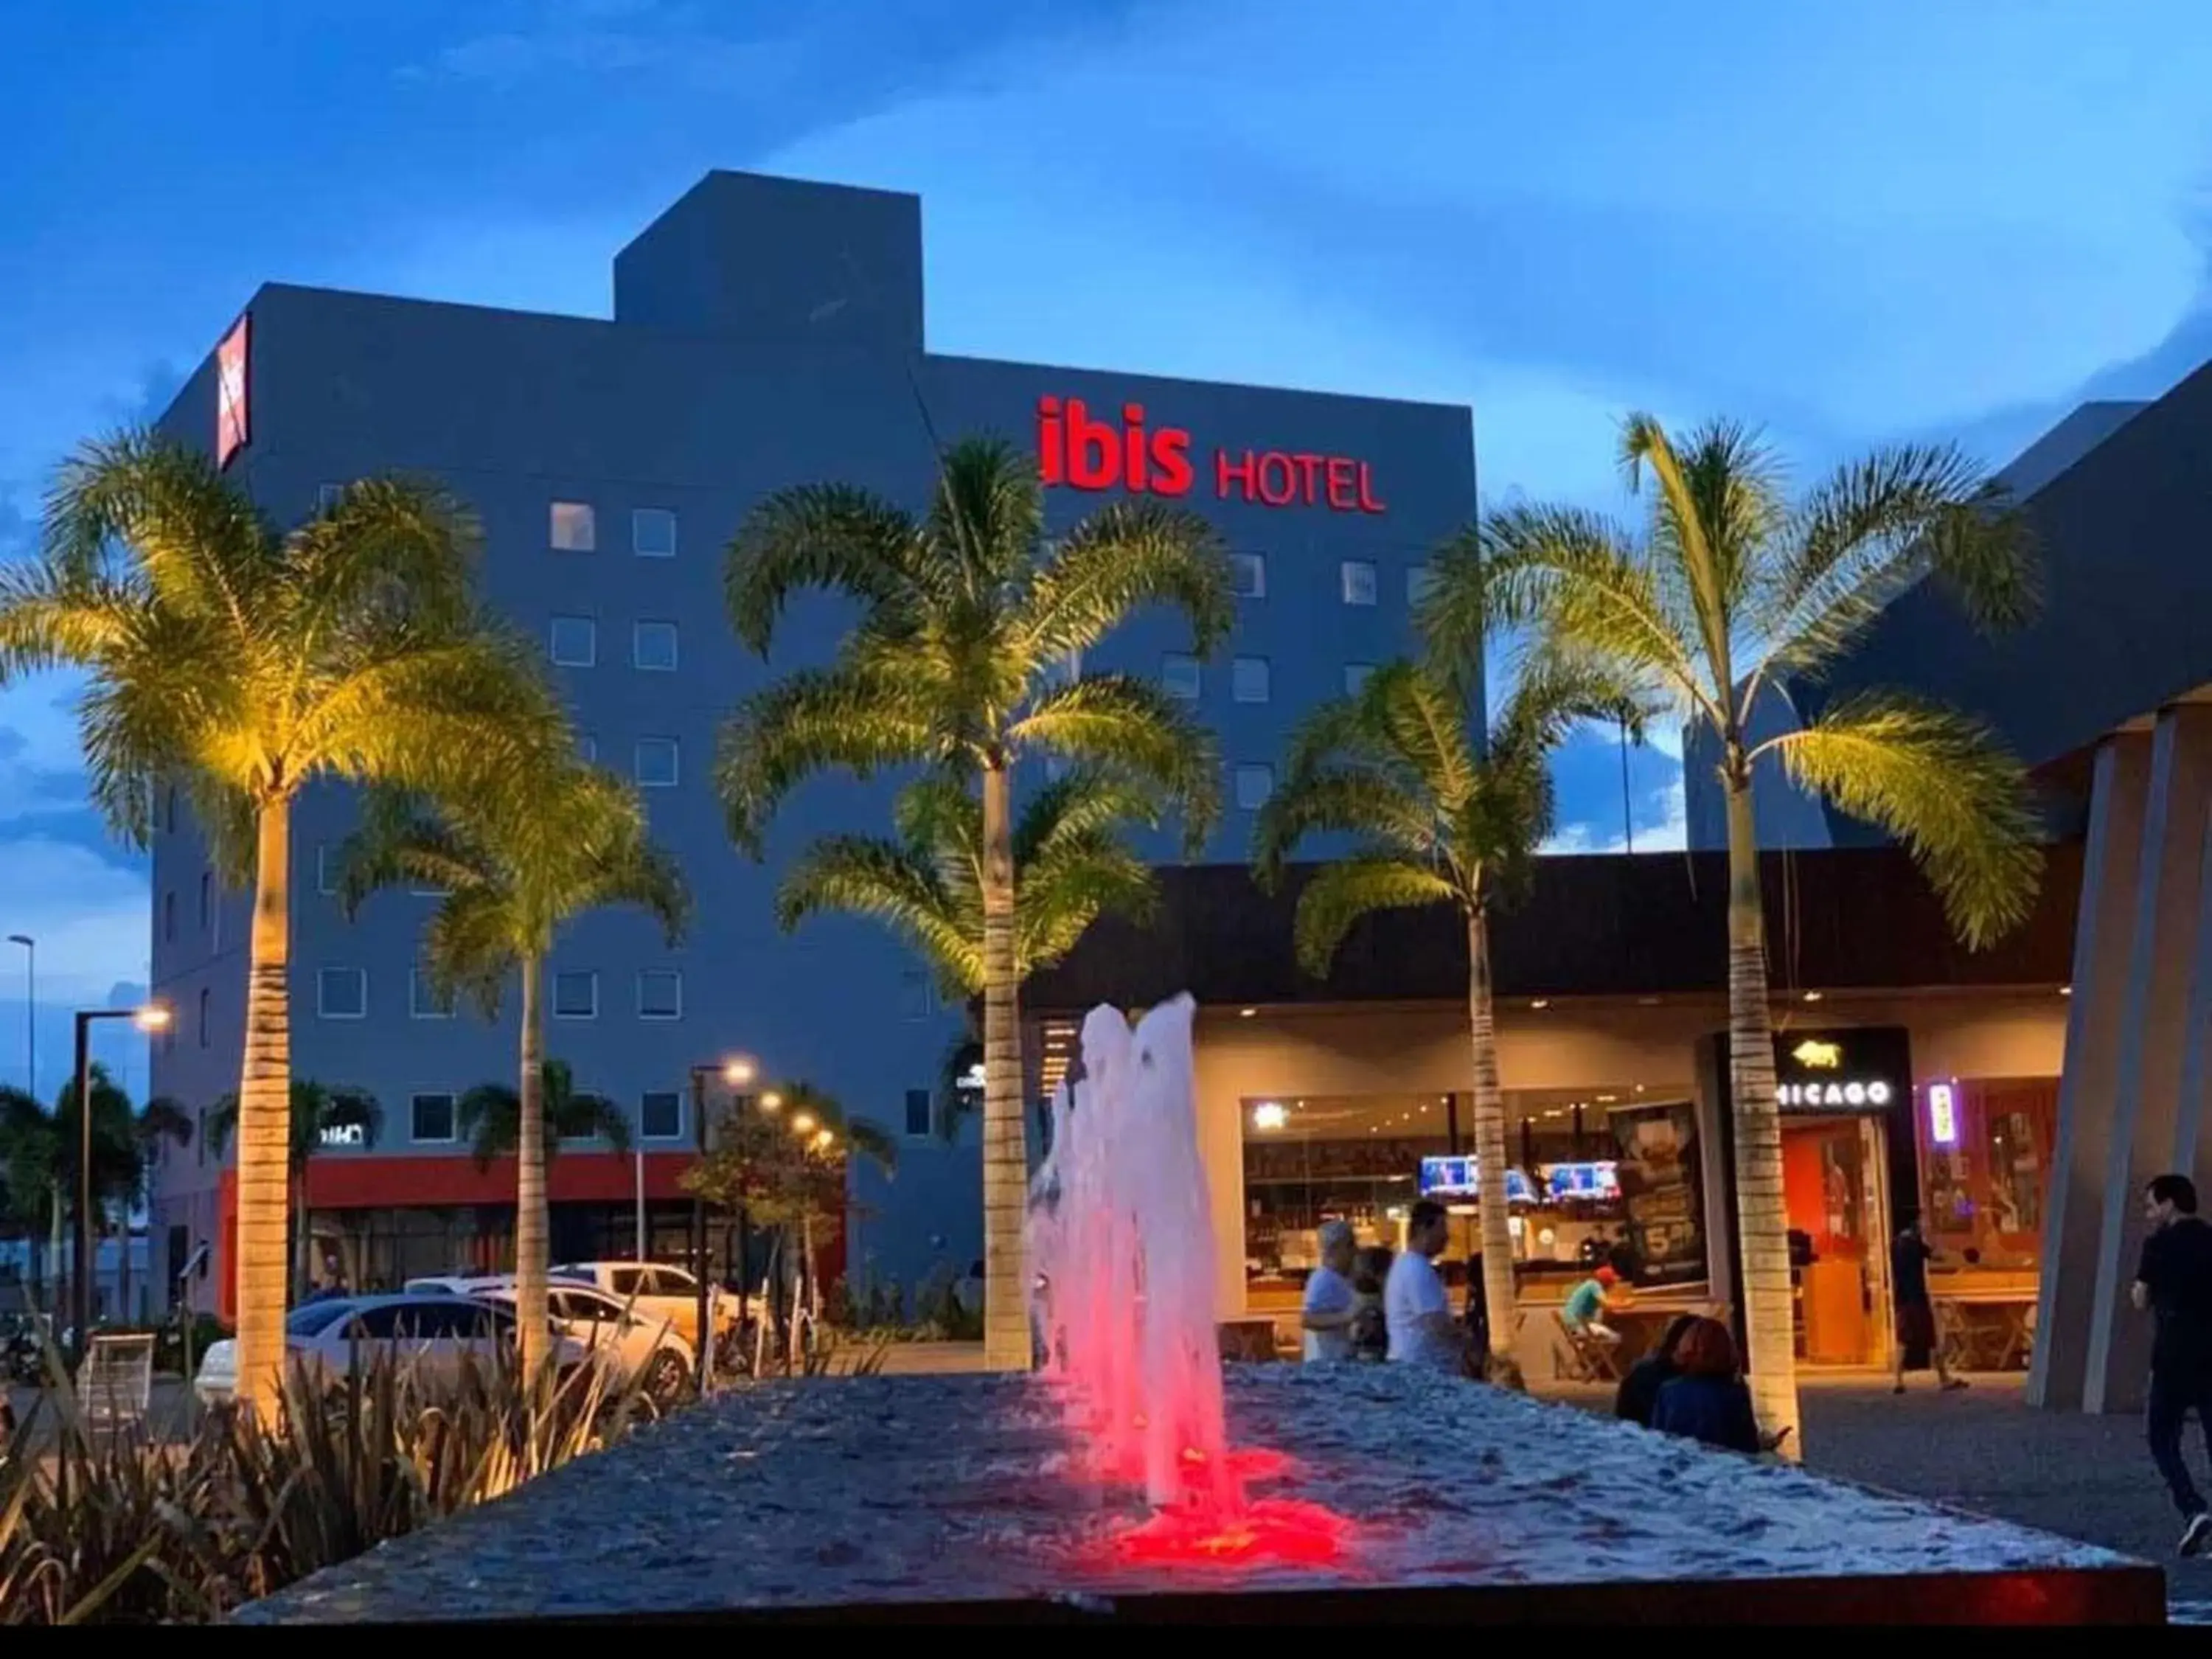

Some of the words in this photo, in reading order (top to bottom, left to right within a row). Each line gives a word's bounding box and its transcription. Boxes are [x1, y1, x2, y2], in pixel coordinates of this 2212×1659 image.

[1038, 395, 1194, 497] ibis
[1216, 448, 1386, 512] HOTEL
[1775, 1082, 1890, 1106] HICAGO
